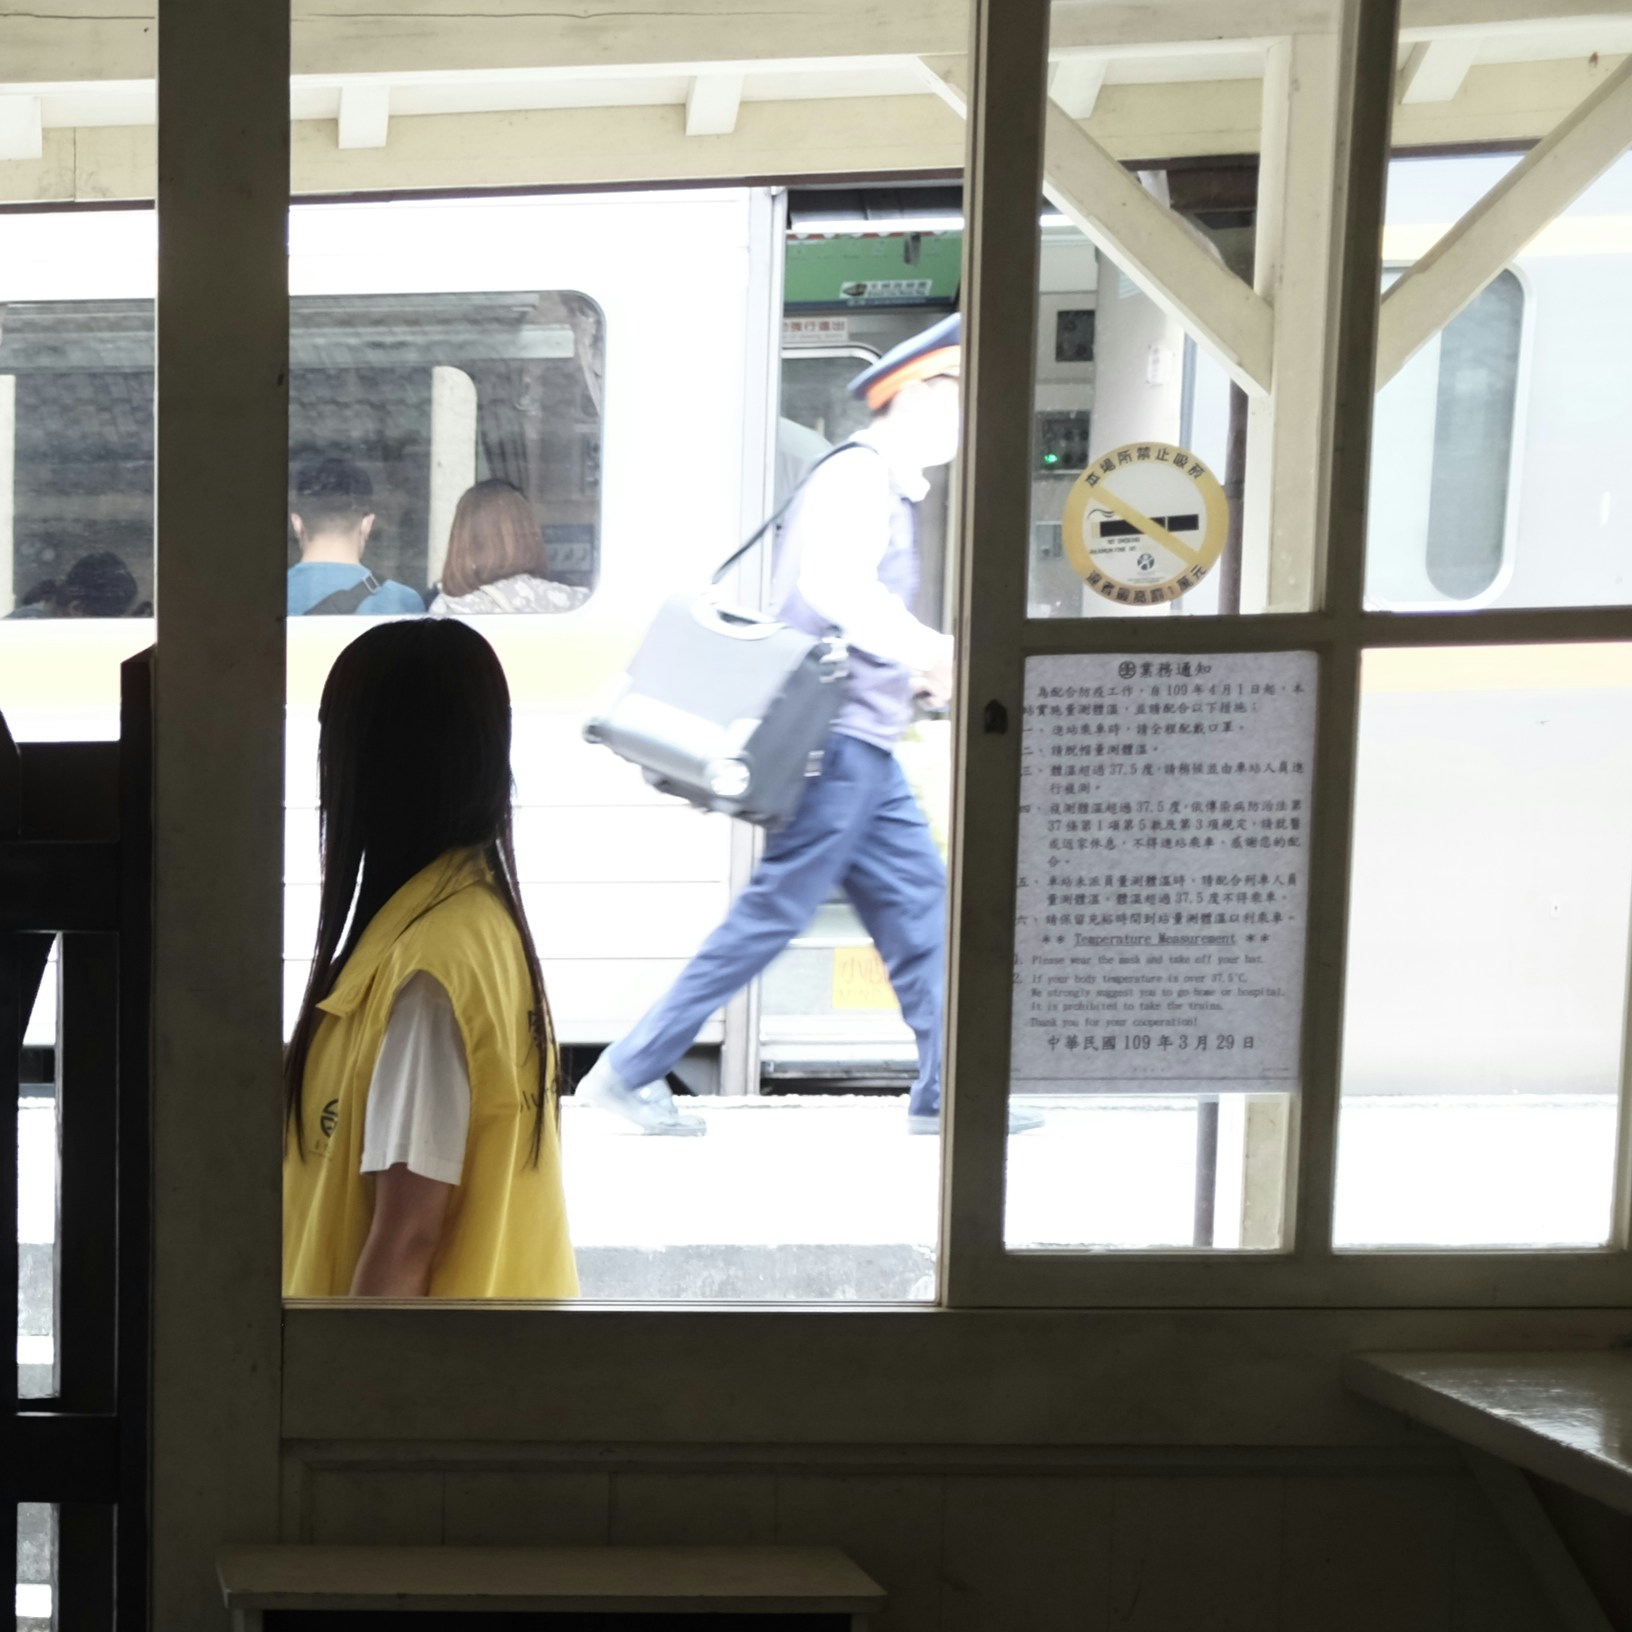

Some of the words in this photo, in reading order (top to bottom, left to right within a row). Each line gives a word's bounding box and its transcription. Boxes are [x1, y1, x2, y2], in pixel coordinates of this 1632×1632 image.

[1140, 661, 1213, 678] 業務通知
[1075, 933, 1152, 946] Temperature
[1158, 932, 1236, 945] Measurement
[1032, 955, 1065, 965] Please
[1070, 957, 1092, 965] wear
[1098, 955, 1114, 964] the
[1194, 953, 1211, 964] off
[1217, 956, 1240, 965] your
[1033, 974, 1043, 984] If
[1047, 976, 1069, 985] your
[1074, 975, 1097, 984] body
[1103, 974, 1162, 984] temperature
[1168, 974, 1179, 983] is
[1183, 975, 1205, 983] over
[1047, 988, 1090, 998] strongly
[1096, 989, 1133, 998] suggest
[1162, 988, 1173, 997] to
[1177, 989, 1190, 998] go
[1221, 988, 1233, 996] or
[1032, 1002, 1041, 1011] It
[1047, 1003, 1058, 1011] is
[1063, 1002, 1117, 1012] prohibited
[1124, 1002, 1134, 1011] to
[1030, 1017, 1057, 1027] Thank
[1063, 1019, 1079, 1028] you
[1085, 1017, 1100, 1027] for
